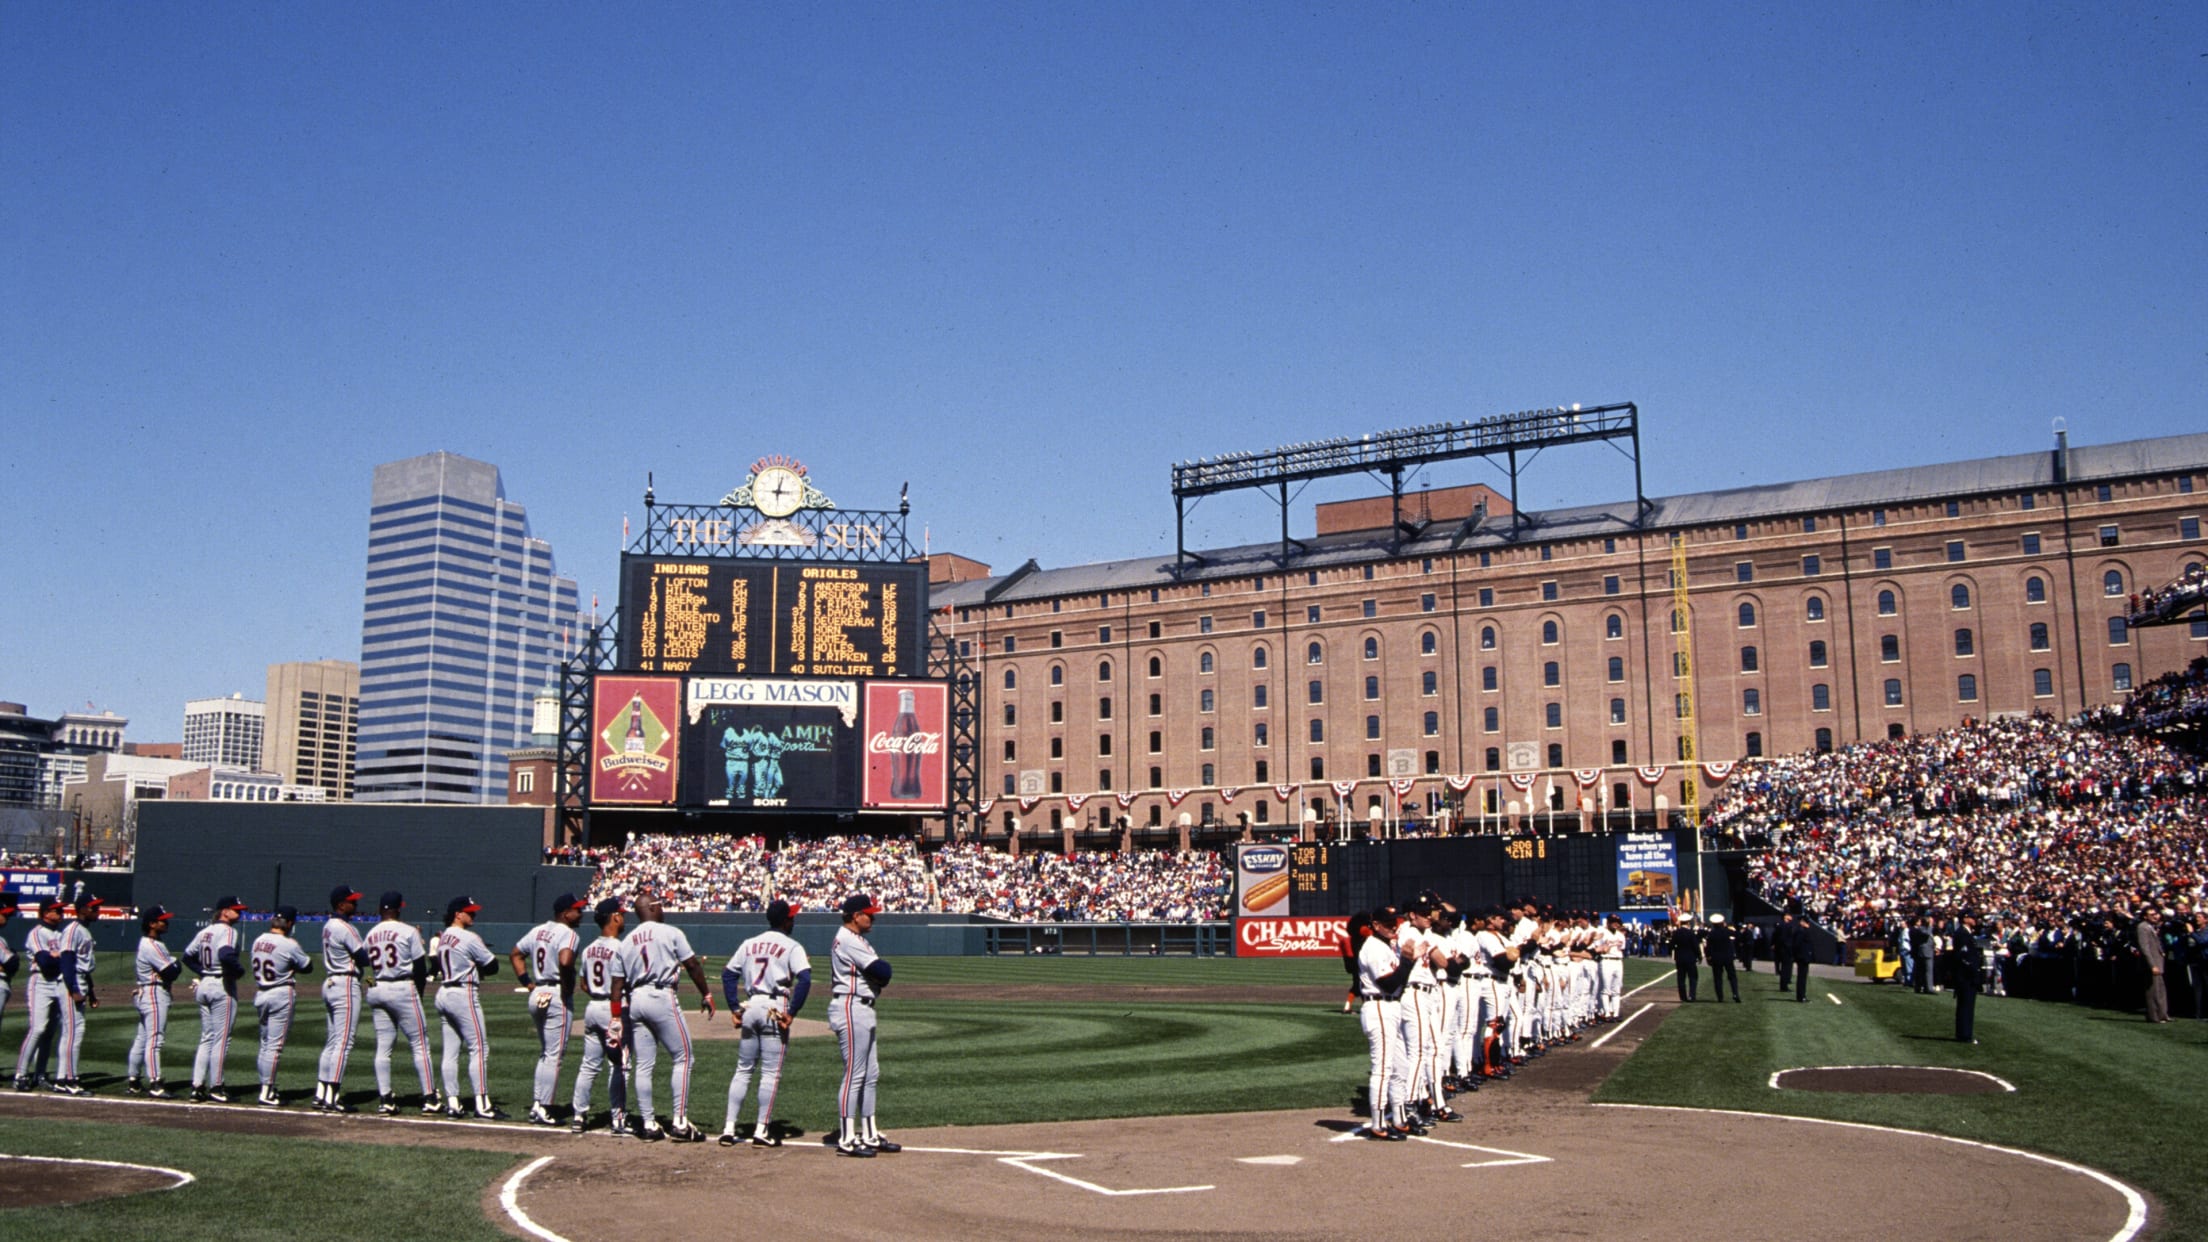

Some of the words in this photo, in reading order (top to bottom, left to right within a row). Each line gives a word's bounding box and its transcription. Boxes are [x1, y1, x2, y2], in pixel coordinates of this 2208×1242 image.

[751, 455, 807, 477] ORIOLES
[671, 519, 732, 544] THE
[824, 524, 883, 549] SUN
[654, 564, 709, 575] INDIANS
[803, 568, 858, 579] ORIOLES
[650, 577, 658, 586] 7
[666, 578, 708, 588] LOFTON
[799, 581, 807, 590] 9
[814, 582, 869, 592] ANDERSON
[651, 586, 656, 595] 1
[666, 586, 694, 596] HILL
[799, 591, 806, 599] 6
[814, 591, 862, 600] ORSULAK
[650, 595, 658, 603] 9
[666, 595, 707, 605] BAERGA
[799, 599, 806, 608] 8
[650, 603, 657, 613] 8
[665, 603, 699, 613] BELLE
[792, 607, 806, 616] 37
[643, 612, 657, 621] 11
[665, 613, 720, 623] SORRENTO
[792, 616, 806, 625] 12
[814, 616, 875, 627] DEVEREAUX
[642, 621, 656, 630] 23
[665, 621, 706, 631] WHITEN
[814, 625, 842, 635] HORN
[642, 630, 656, 639] 15
[664, 630, 706, 640] ALOMAR
[792, 634, 806, 643] 10
[813, 634, 848, 644] GOMEZ
[641, 639, 656, 648] 26
[664, 639, 706, 649] JACOBY
[791, 643, 806, 652] 23
[813, 643, 854, 653] HOILES
[641, 648, 656, 657] 10
[664, 648, 699, 658] LEWIS
[798, 652, 805, 661] 3
[640, 661, 654, 671] 41
[663, 662, 692, 672] NAGY
[790, 665, 805, 674] 40
[813, 665, 874, 676] SUTCLIFFE
[695, 682, 754, 701] LEGG
[765, 684, 850, 703] MASON
[869, 731, 941, 754] Coca-Cola
[603, 755, 666, 769] Budweiser
[1516, 752, 1530, 766] C
[1627, 833, 1654, 842] Moving
[1655, 832, 1662, 840] is
[1512, 841, 1532, 849] SDG
[1620, 844, 1637, 852] easy
[1638, 842, 1657, 850] when
[1658, 843, 1672, 851] you
[1298, 848, 1316, 856] TOR
[1512, 849, 1532, 858] CIN
[1626, 852, 1642, 860] have
[1654, 851, 1666, 859] the
[1243, 854, 1285, 869] ESSKAY
[1298, 856, 1316, 864] DET
[1299, 873, 1316, 881] MIN
[1299, 882, 1316, 891] MIL
[368, 930, 399, 945] WHITEN
[632, 929, 654, 946] HILL
[1242, 921, 1350, 946] CHAMPS
[745, 942, 787, 960] LOFTON
[1270, 939, 1320, 953] Sports
[369, 943, 399, 970] 23
[587, 946, 614, 960] BAERGA
[536, 947, 546, 974] 8
[641, 945, 649, 973] 1
[253, 957, 276, 983] 26
[592, 961, 604, 987] 9
[754, 957, 769, 986] 7
